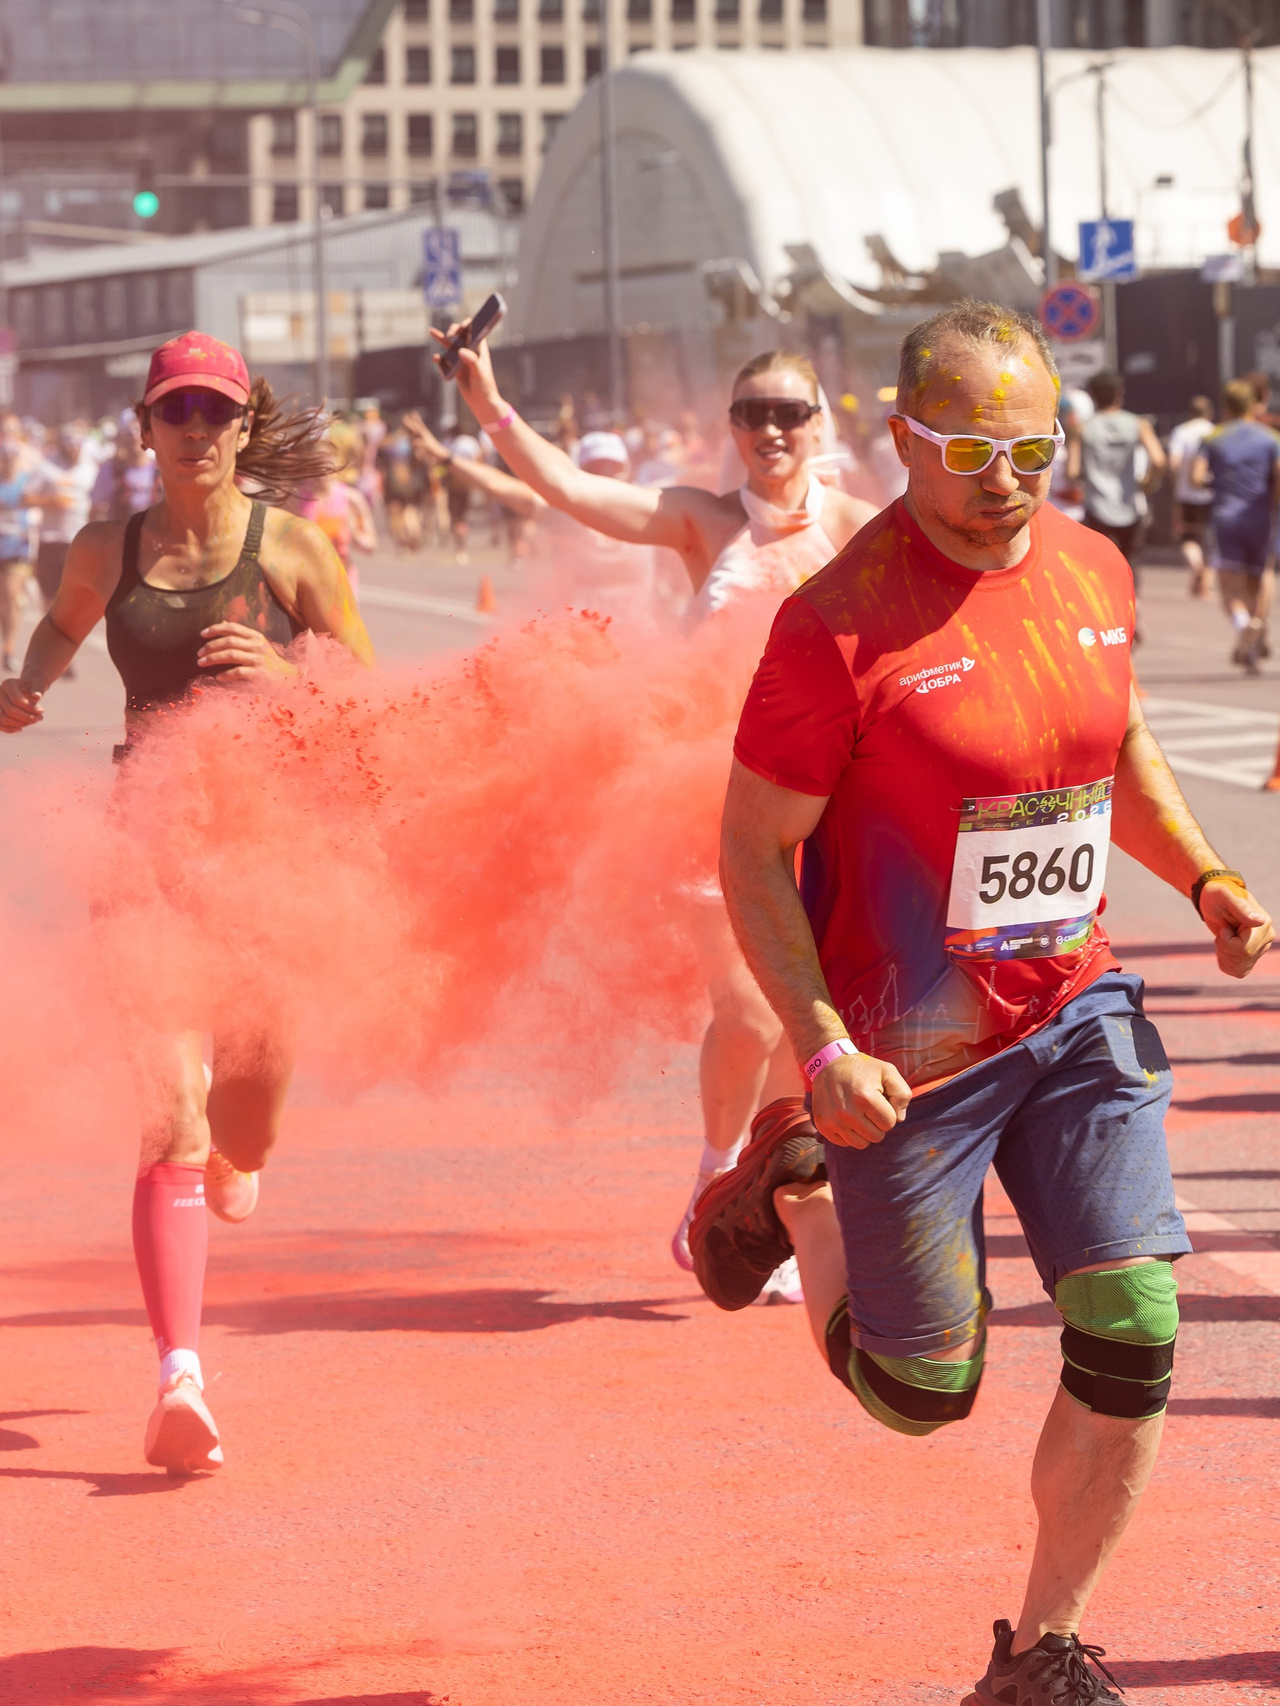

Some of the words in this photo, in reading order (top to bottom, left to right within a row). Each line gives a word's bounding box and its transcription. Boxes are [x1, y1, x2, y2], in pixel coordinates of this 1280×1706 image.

[1099, 627, 1128, 647] МКБ
[976, 782, 1106, 819] КРАСОЧНЫЙ
[1057, 800, 1112, 825] 2026
[978, 843, 1095, 905] 5860
